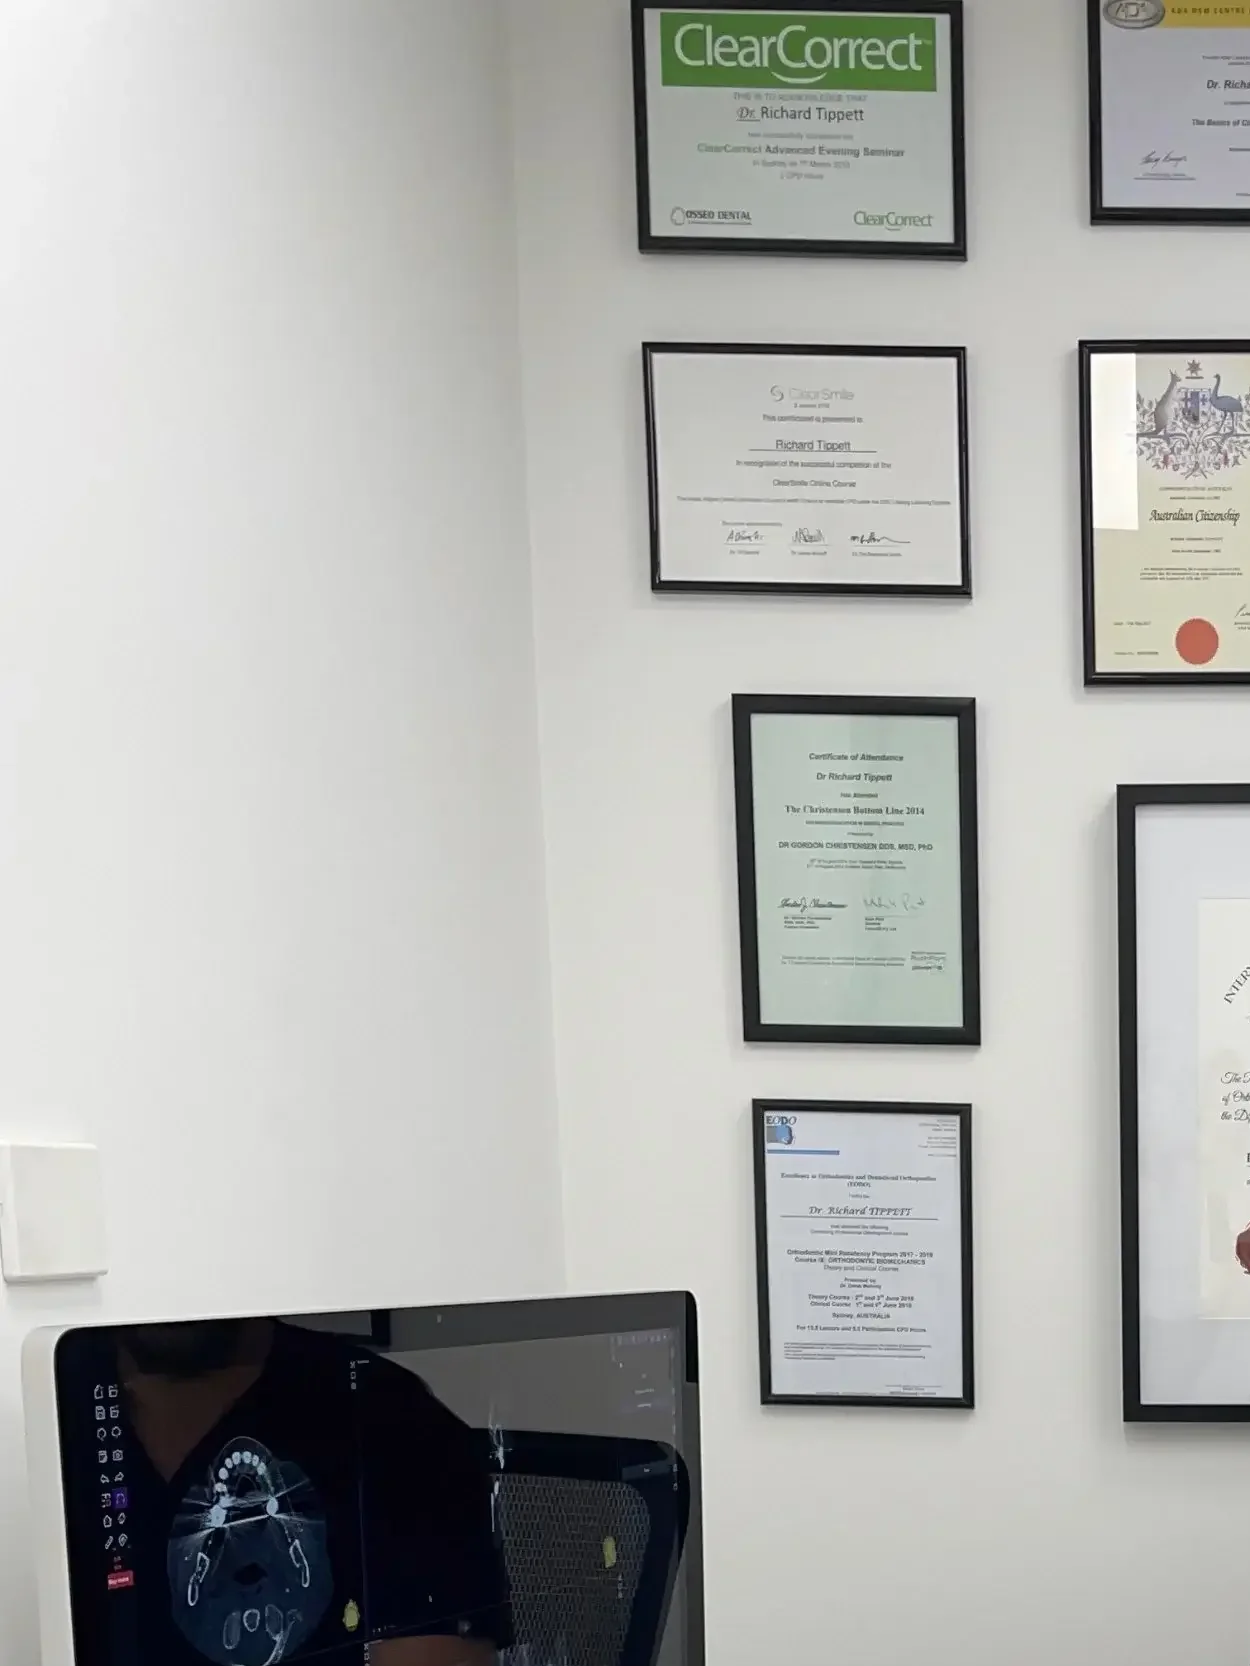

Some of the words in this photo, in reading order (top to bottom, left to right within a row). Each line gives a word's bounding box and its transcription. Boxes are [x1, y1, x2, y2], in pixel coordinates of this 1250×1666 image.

[674, 24, 923, 71] ClearCorrect
[761, 106, 811, 120] Richard
[816, 108, 864, 122] Tippett
[776, 439, 814, 450] Richard
[1150, 510, 1193, 522] Australian
[1195, 509, 1241, 526] Citizenship
[1220, 1071, 1241, 1086] The
[766, 1115, 797, 1124] EODO
